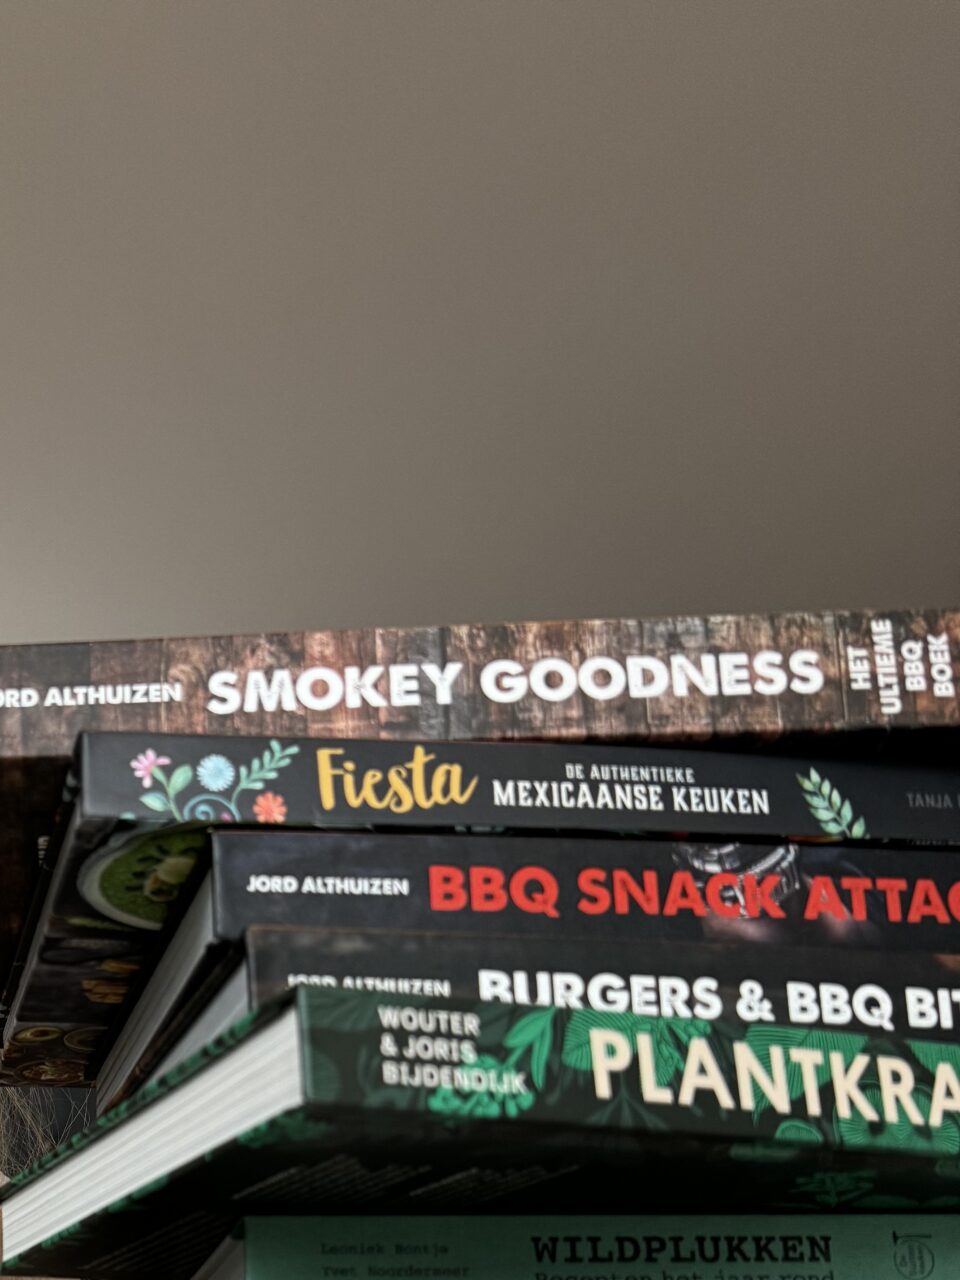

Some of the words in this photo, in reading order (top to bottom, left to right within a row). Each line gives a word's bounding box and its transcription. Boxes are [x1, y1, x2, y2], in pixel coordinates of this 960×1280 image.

[44, 682, 183, 707] ALTHUIZEN
[207, 661, 463, 715] SMOKEY
[480, 650, 825, 703] GOODNESS
[847, 645, 872, 691] HET
[871, 618, 903, 715] ULTIEME
[901, 640, 927, 692] BBQ
[927, 633, 956, 698] BOEK
[316, 744, 479, 814] Fiesta
[492, 779, 664, 812] MEXICAANSE
[673, 784, 770, 815] KEUKEN
[565, 763, 585, 780] DE
[590, 764, 695, 784] AUTHENTIEKE
[246, 875, 298, 894] JORD
[301, 876, 409, 896] ALTHUIZEN
[428, 864, 559, 918] BBQ
[577, 868, 786, 920] SNACK
[377, 1005, 481, 1037] WOUTER
[478, 968, 723, 1021] BURGERS
[736, 979, 776, 1022] &
[786, 981, 895, 1031] BBQ
[380, 1032, 397, 1057] &
[402, 1036, 478, 1065] JORIS
[382, 1061, 528, 1096] BIJDENDIJK
[531, 1235, 833, 1264] WILDPLUKKEN
